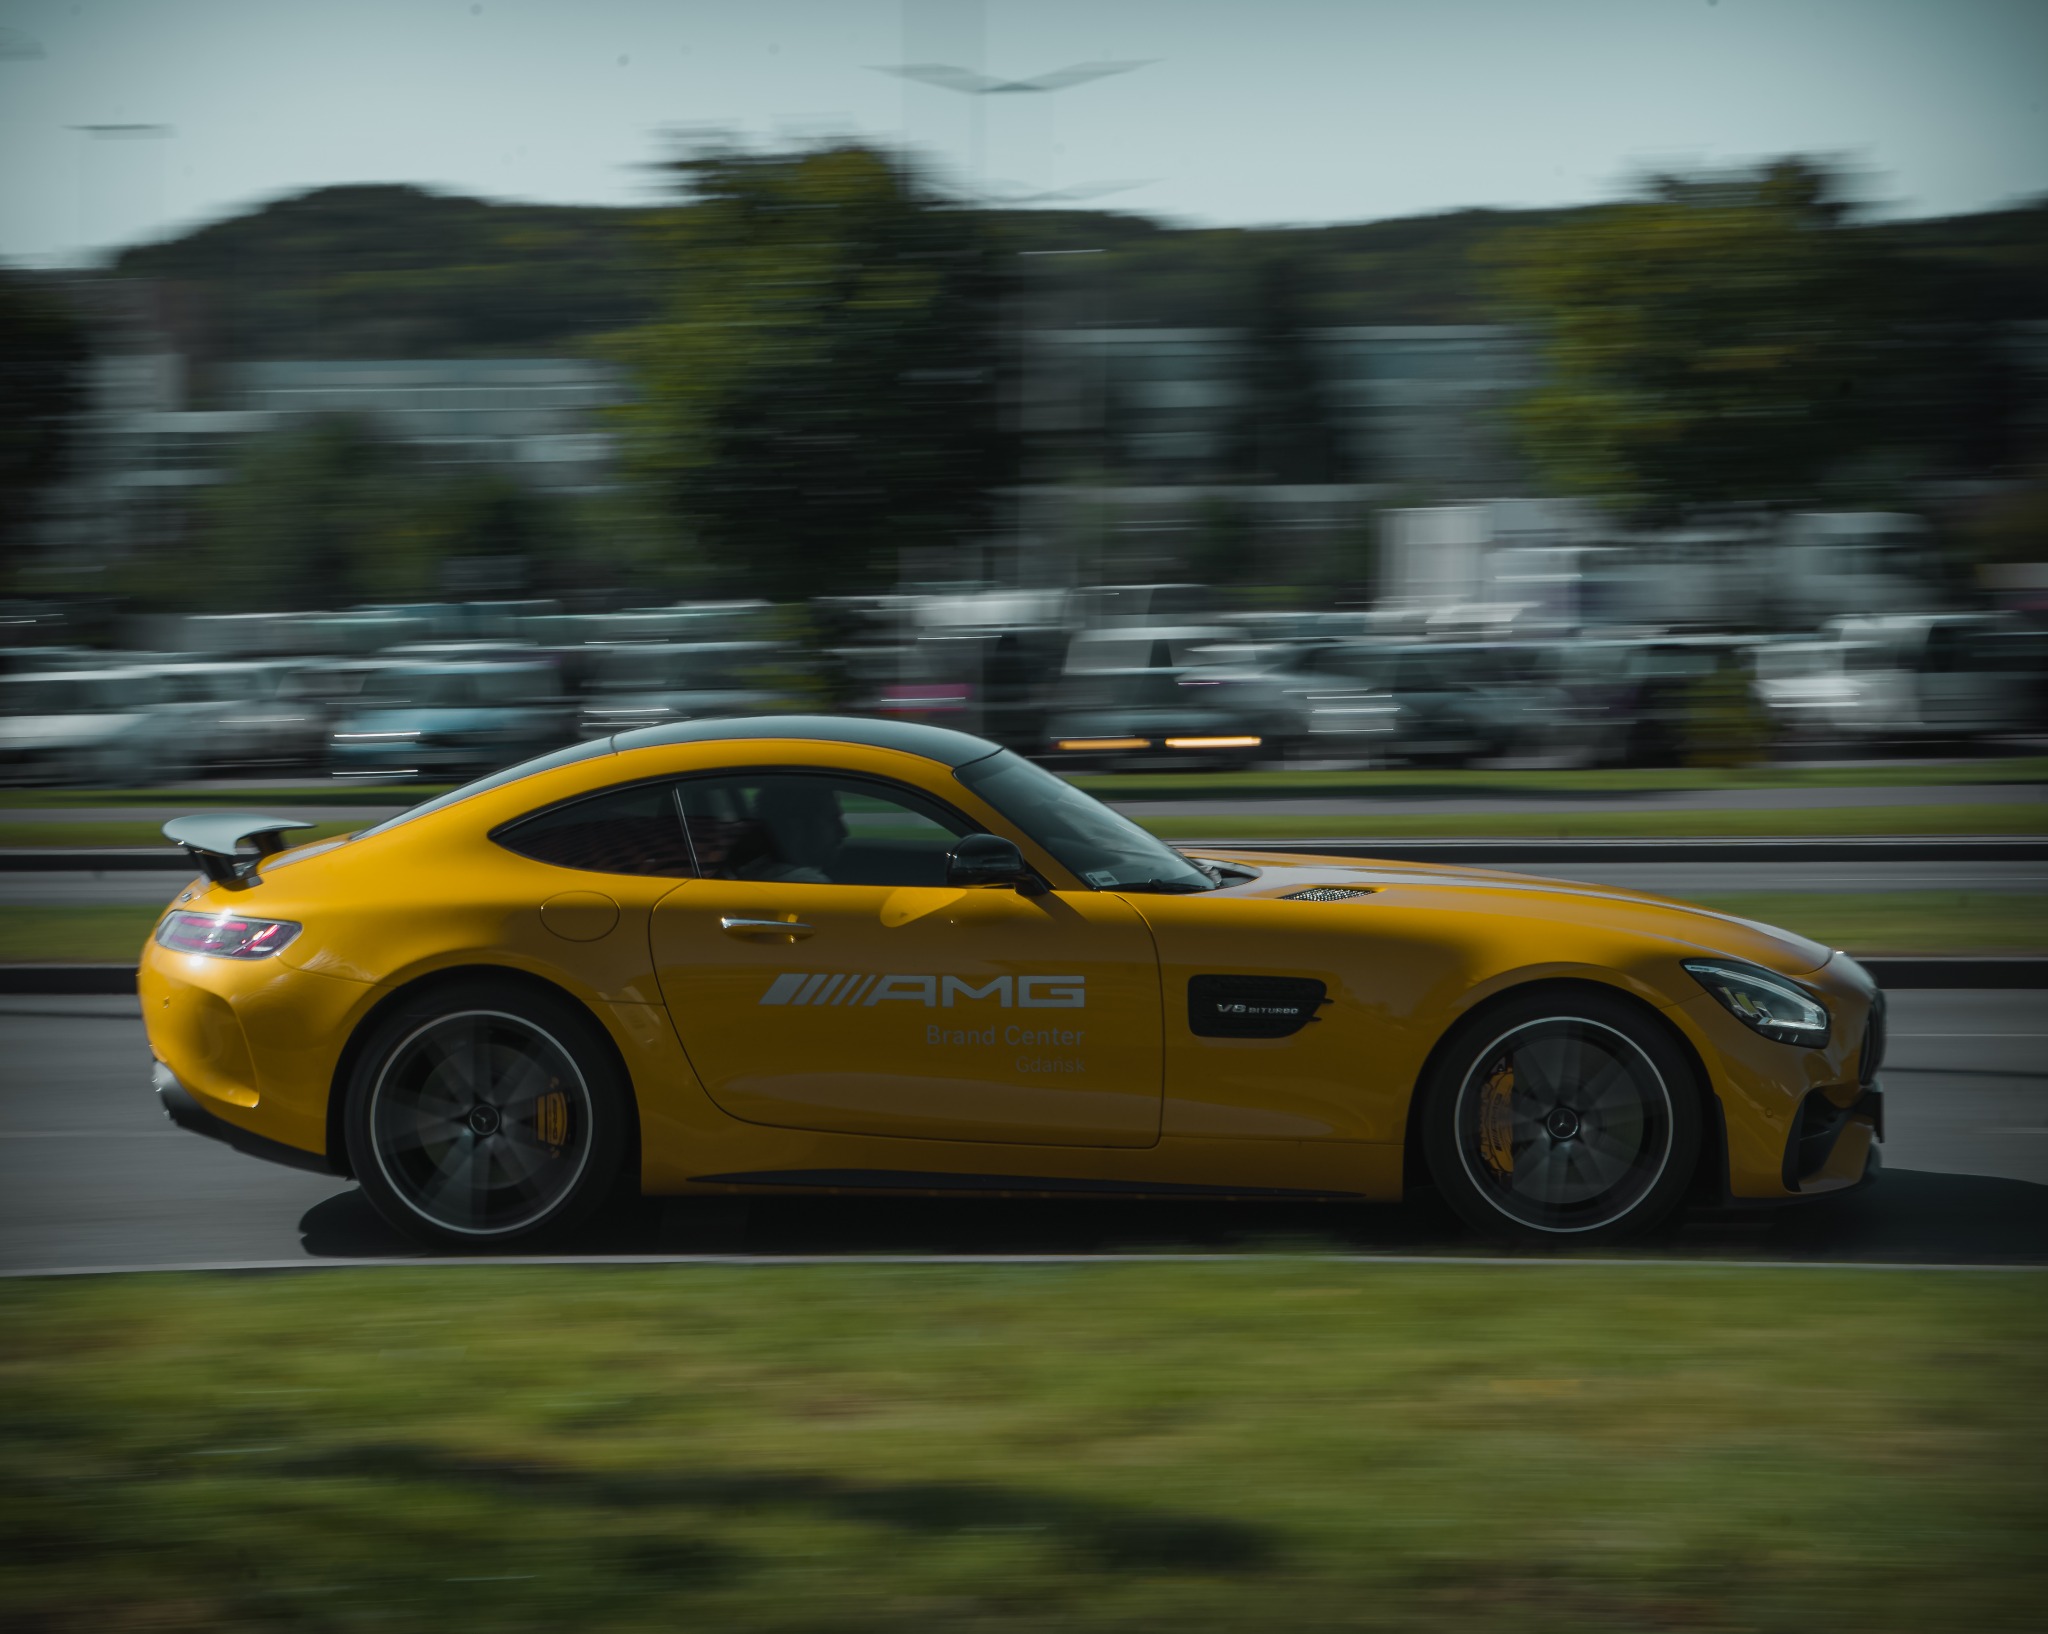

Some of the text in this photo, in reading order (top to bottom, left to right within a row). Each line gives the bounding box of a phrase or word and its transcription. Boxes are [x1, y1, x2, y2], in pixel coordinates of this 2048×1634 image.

[862, 975, 1085, 1008] AMG
[1217, 1004, 1247, 1013] V8
[926, 1025, 1085, 1046] Brand Center
[1015, 1056, 1085, 1073] Gdańsk
